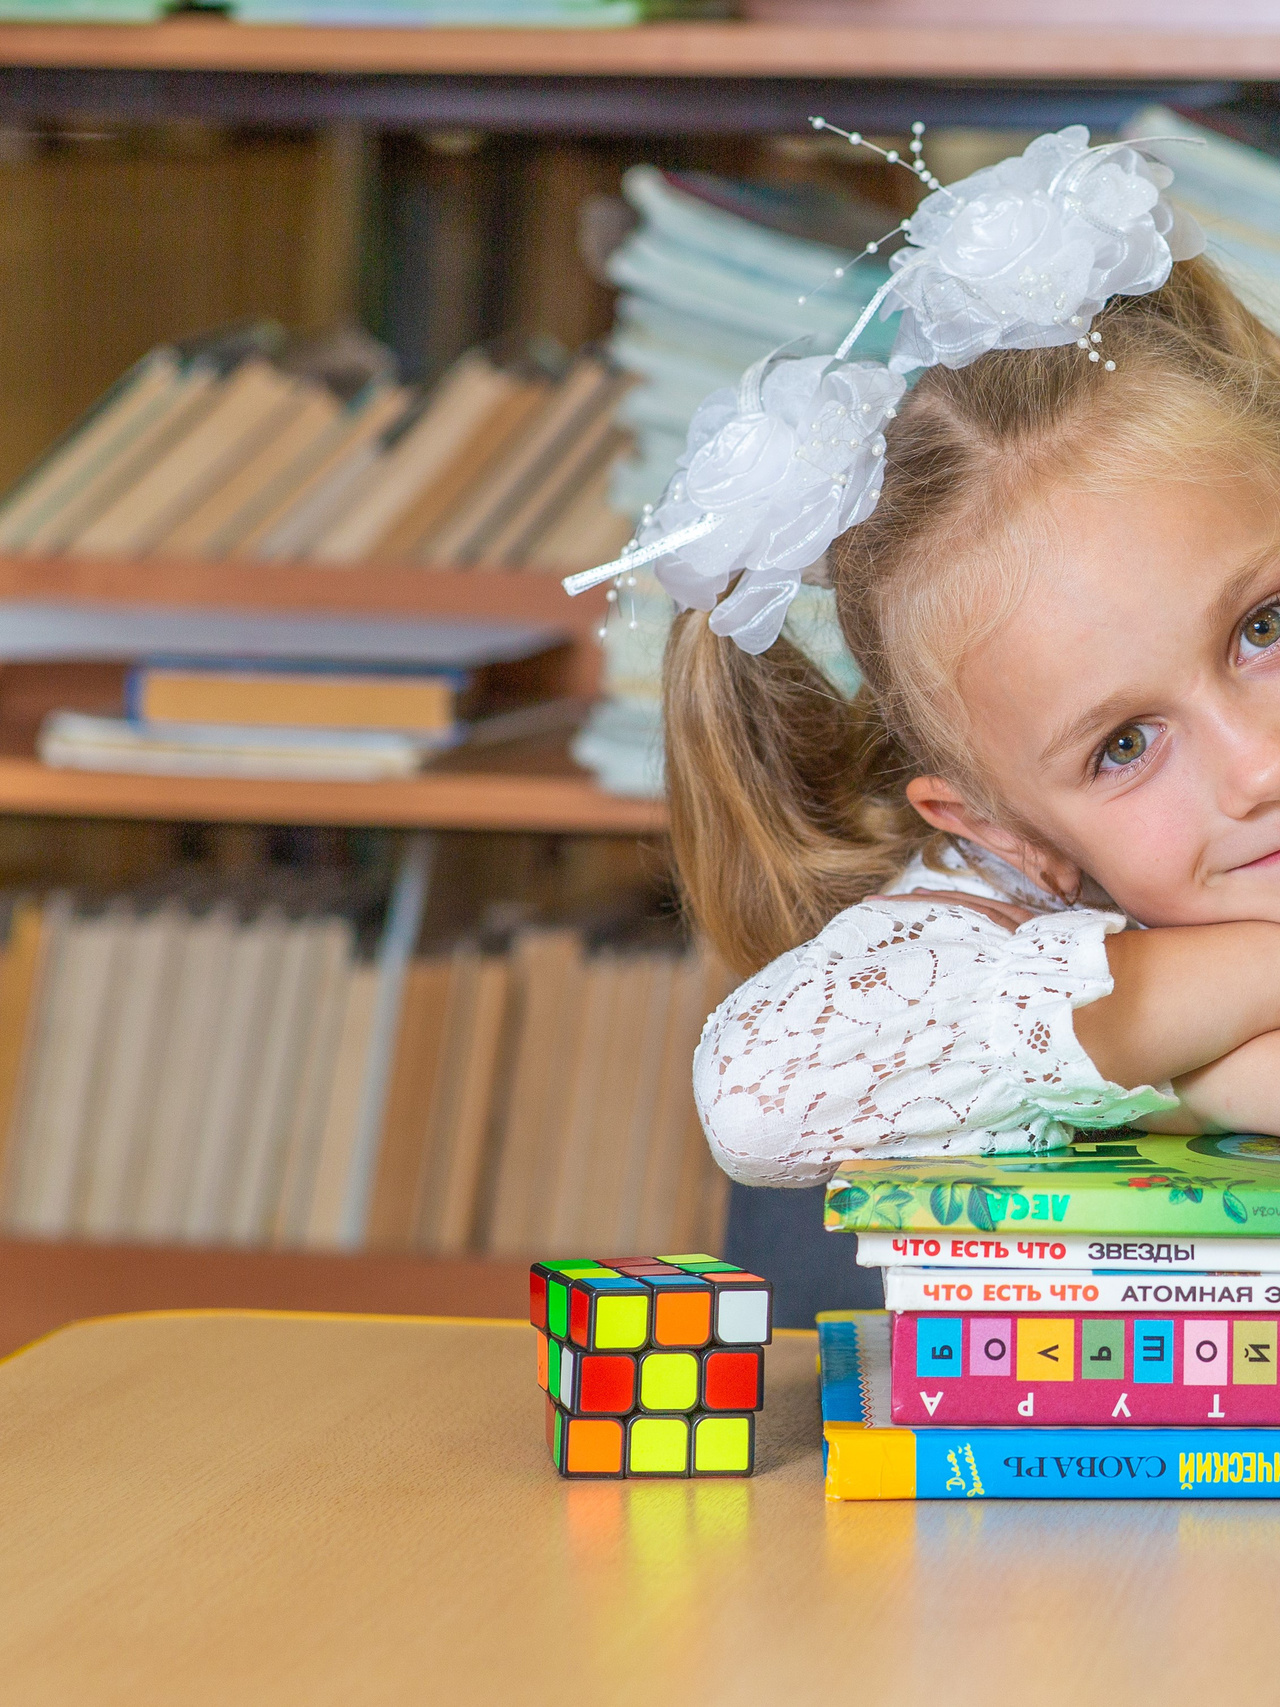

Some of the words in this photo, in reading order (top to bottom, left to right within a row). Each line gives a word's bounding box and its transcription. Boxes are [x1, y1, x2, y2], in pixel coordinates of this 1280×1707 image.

[987, 1193, 1070, 1222] ЛЕСА
[893, 1238, 940, 1257] ЧТО
[951, 1240, 1010, 1258] ЕСТЬ
[1018, 1241, 1067, 1260] ЧТО
[1088, 1242, 1195, 1263] ЗВЕЗДЫ
[923, 1283, 973, 1301] ЧТО
[983, 1284, 1042, 1302] ЕСТЬ
[1049, 1285, 1100, 1302] ЧТО
[1121, 1285, 1253, 1303] АТОМНАЯ
[946, 1448, 966, 1492] Для
[1002, 1456, 1167, 1478] СЛОВАРЬ
